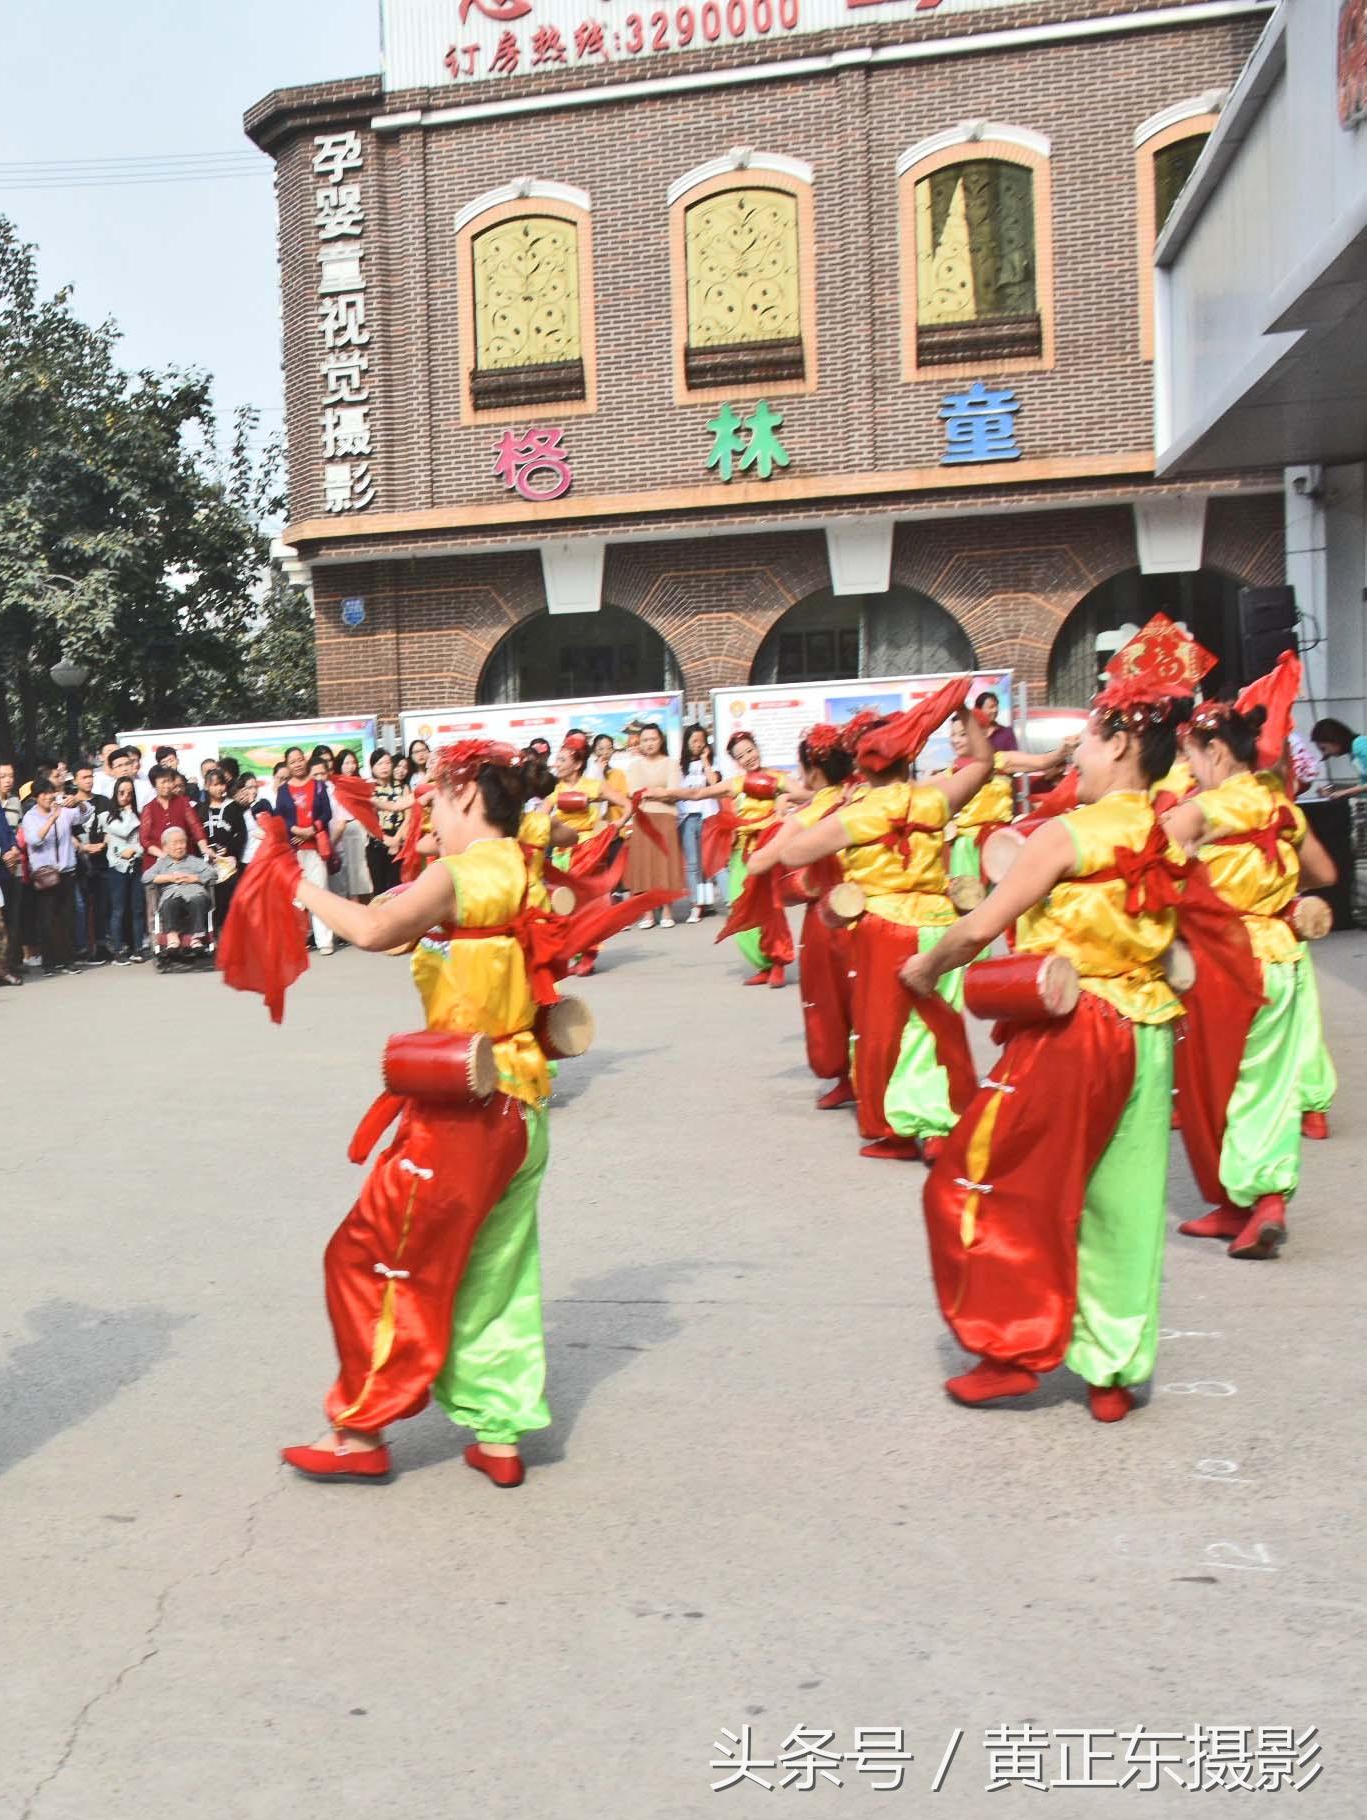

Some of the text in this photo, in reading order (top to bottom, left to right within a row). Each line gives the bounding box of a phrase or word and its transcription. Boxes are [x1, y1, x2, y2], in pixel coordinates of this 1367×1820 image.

[313, 130, 376, 513] 孕婴童视觉摄影
